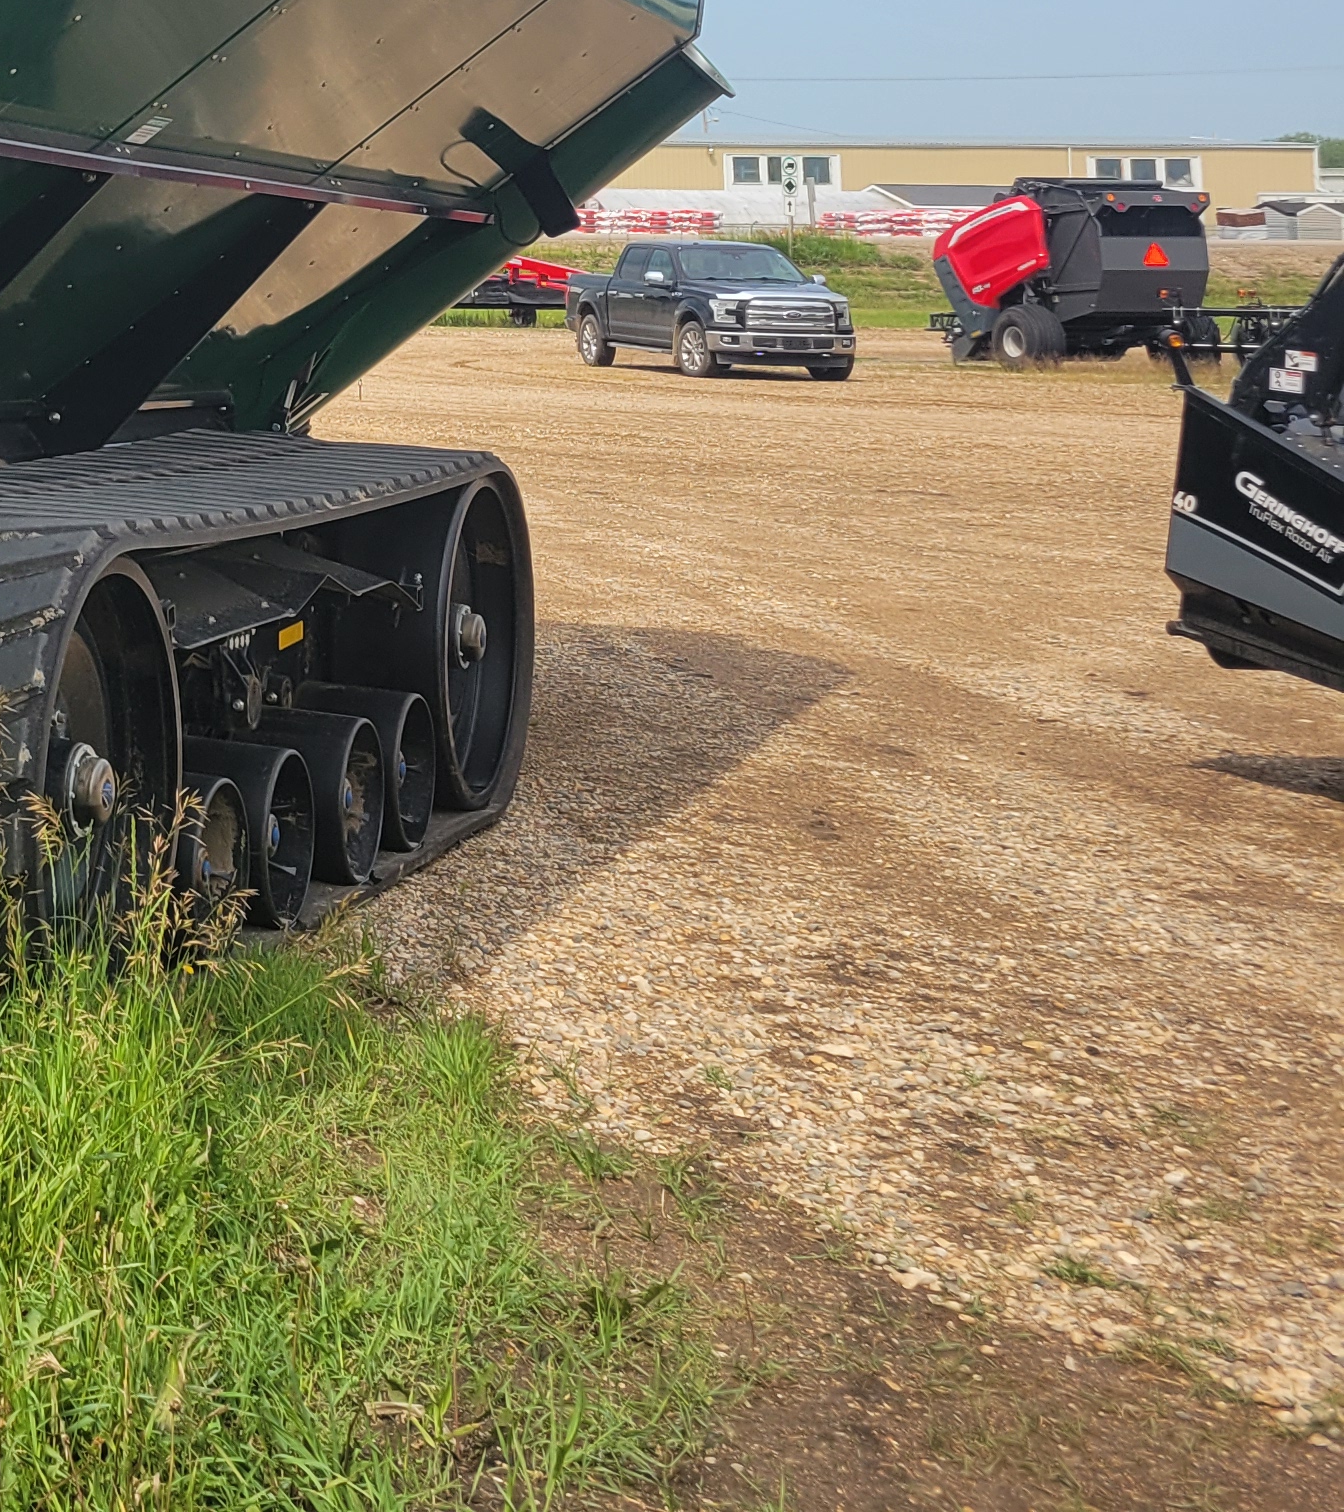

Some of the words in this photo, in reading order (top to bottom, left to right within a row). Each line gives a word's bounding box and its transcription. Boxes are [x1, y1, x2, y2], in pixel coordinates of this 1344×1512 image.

[1173, 491, 1198, 512] 40
[1248, 501, 1284, 533] TruFlex
[1284, 526, 1317, 554] Razor
[1315, 548, 1335, 564] Air
